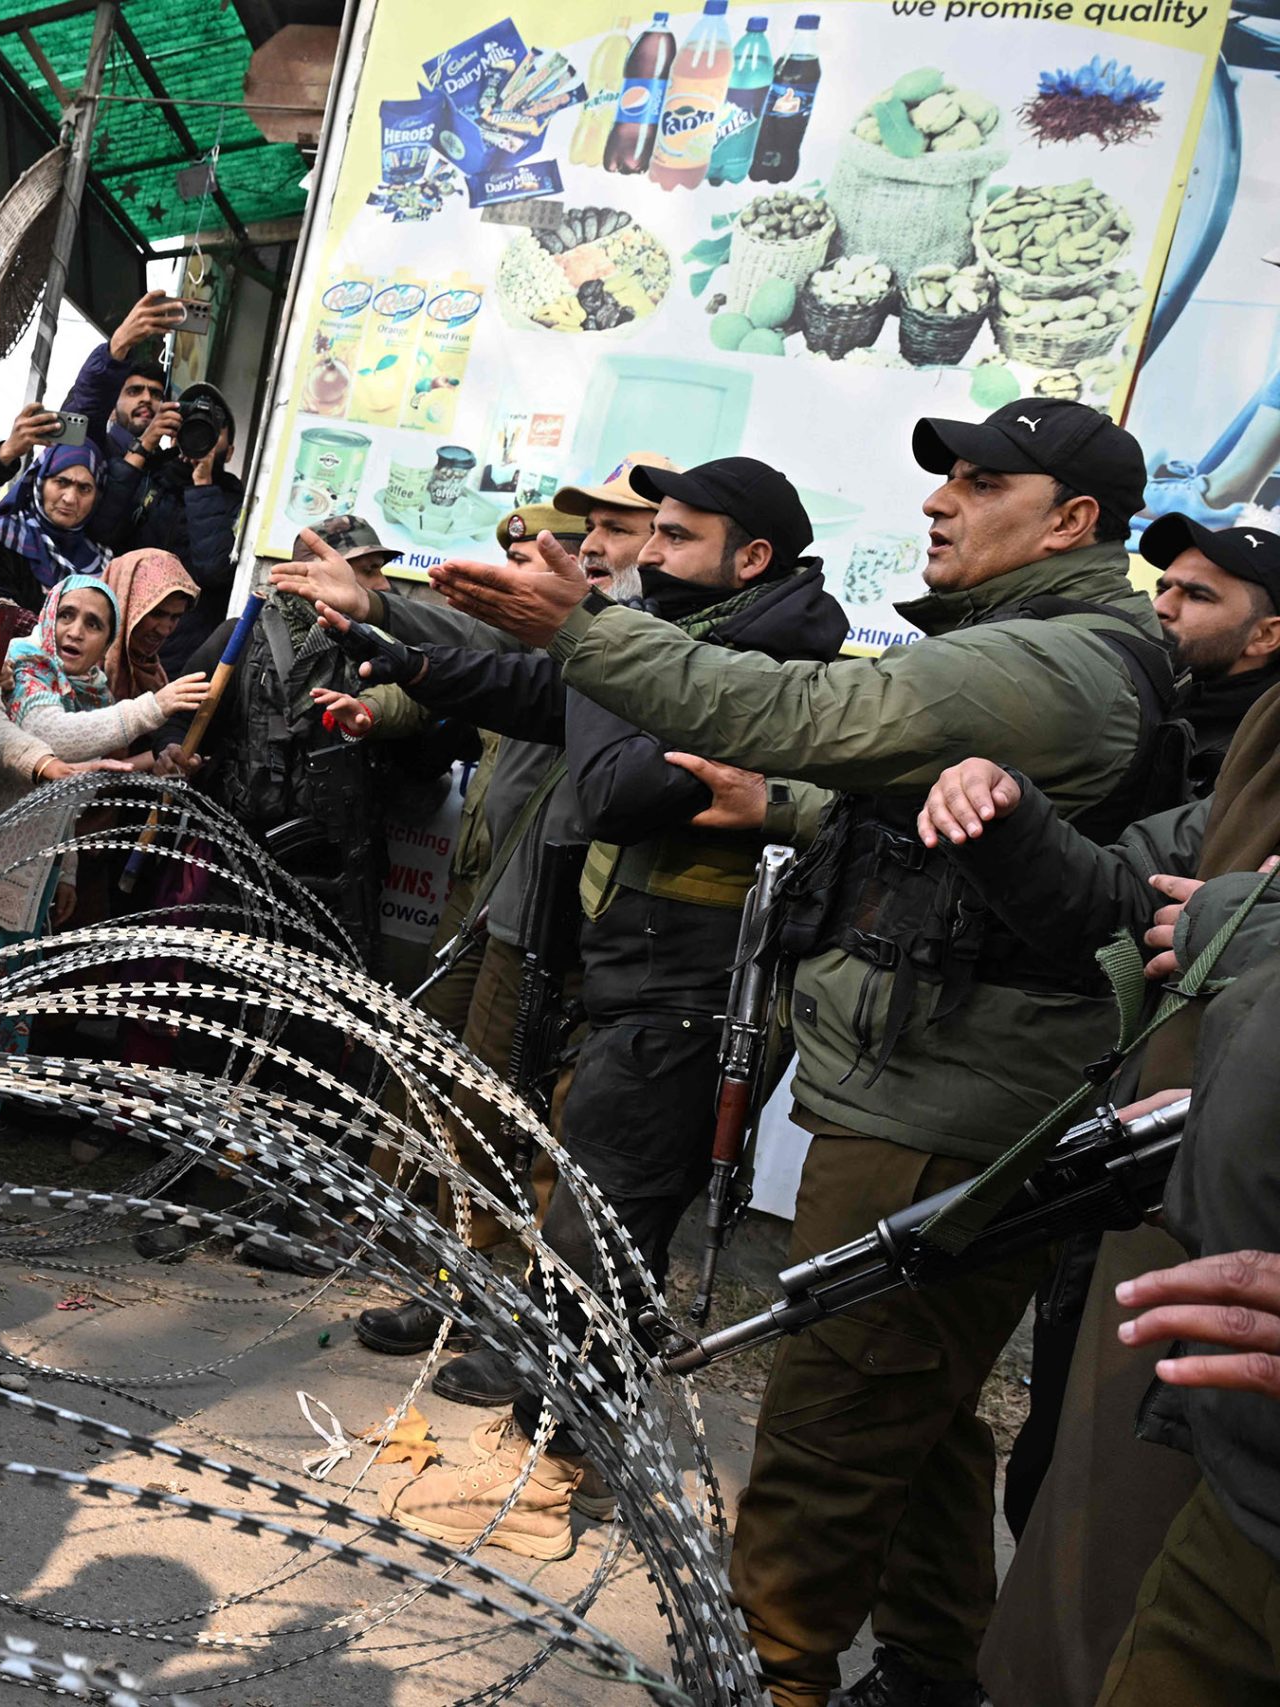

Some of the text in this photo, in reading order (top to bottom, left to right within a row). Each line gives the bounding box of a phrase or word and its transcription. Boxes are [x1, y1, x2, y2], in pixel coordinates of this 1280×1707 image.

[892, 0, 1208, 28] we promise quality
[444, 44, 517, 94] Dairy Milk
[384, 123, 435, 145] HEROES
[485, 171, 540, 194] Dairy Milk
[328, 285, 368, 308] Real
[379, 288, 420, 312] Real
[434, 293, 476, 319] Real
[377, 323, 409, 337] Orange
[424, 330, 470, 343] Mixed Fruit
